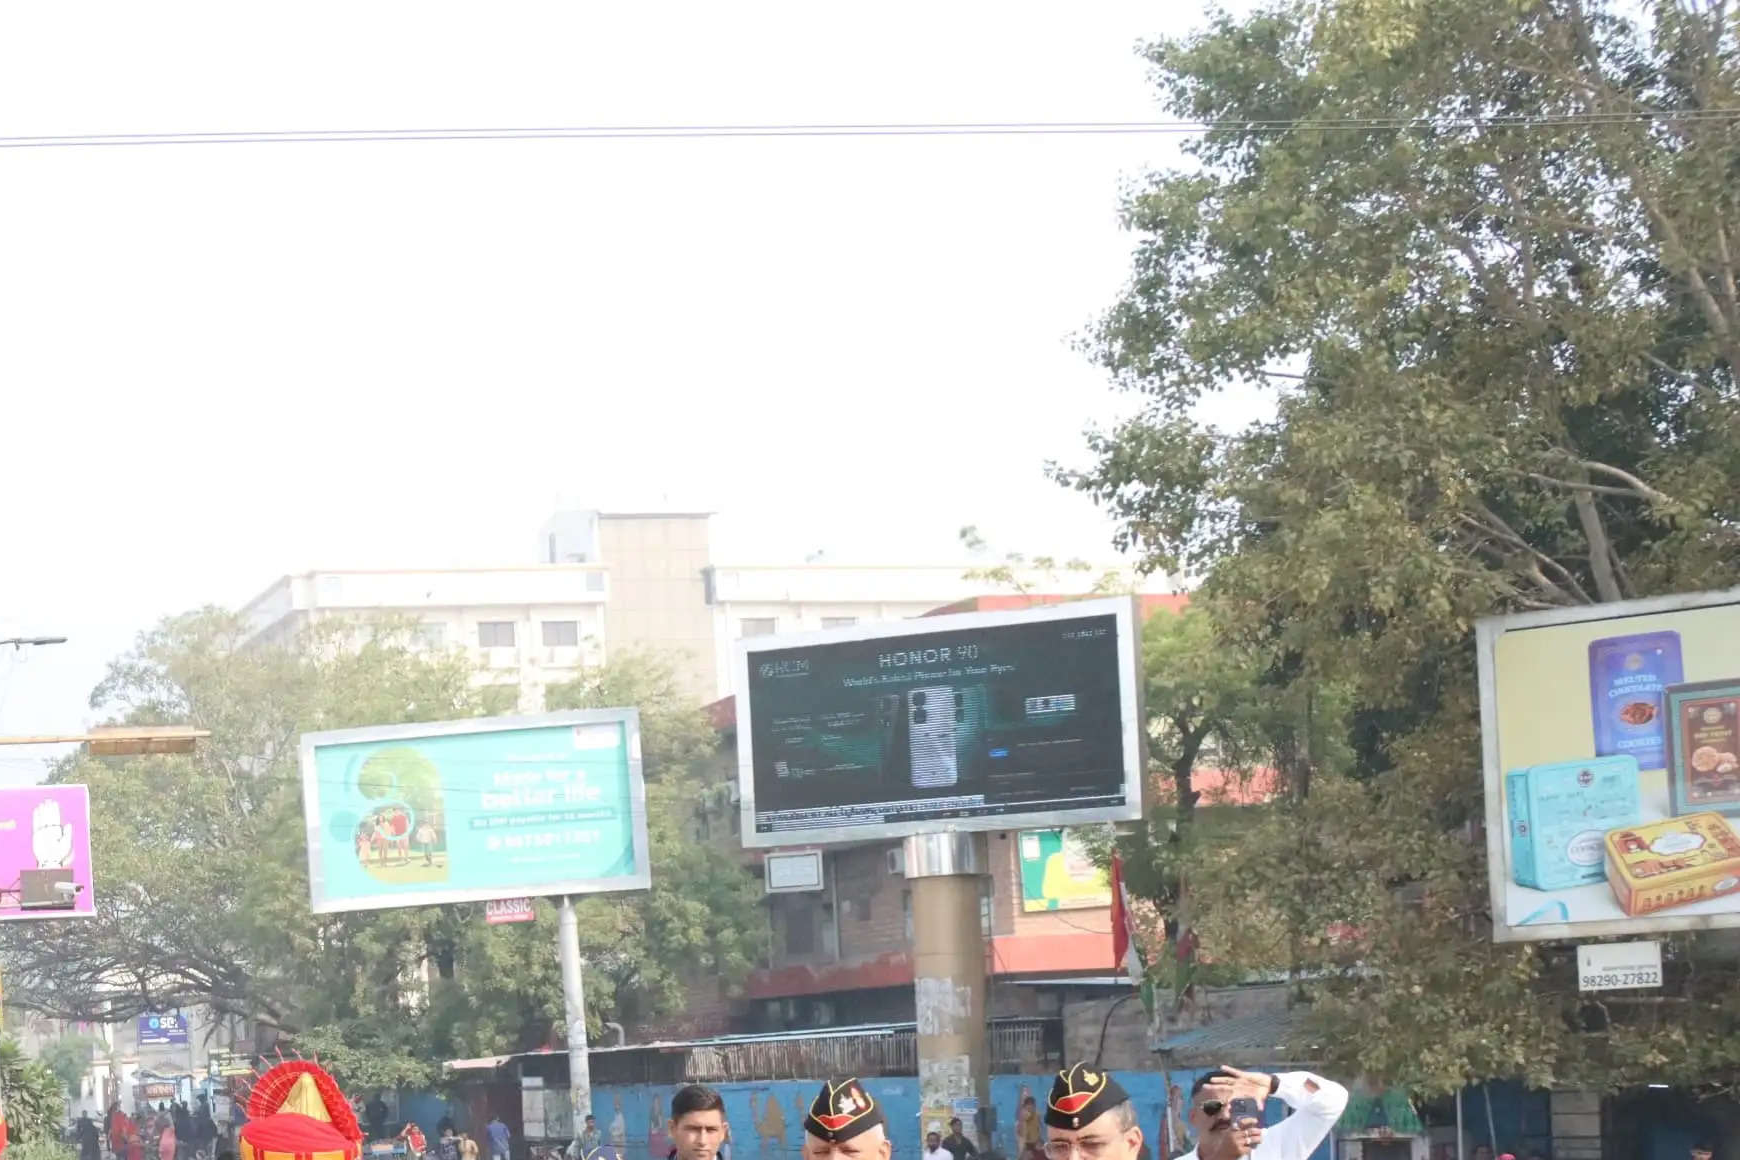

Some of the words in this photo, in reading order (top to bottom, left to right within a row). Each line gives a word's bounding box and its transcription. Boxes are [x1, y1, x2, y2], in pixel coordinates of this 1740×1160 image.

[879, 647, 950, 668] HONOR
[958, 644, 978, 660] 90
[485, 898, 531, 913] CLASSIC
[1582, 972, 1659, 989] 98290-27822
